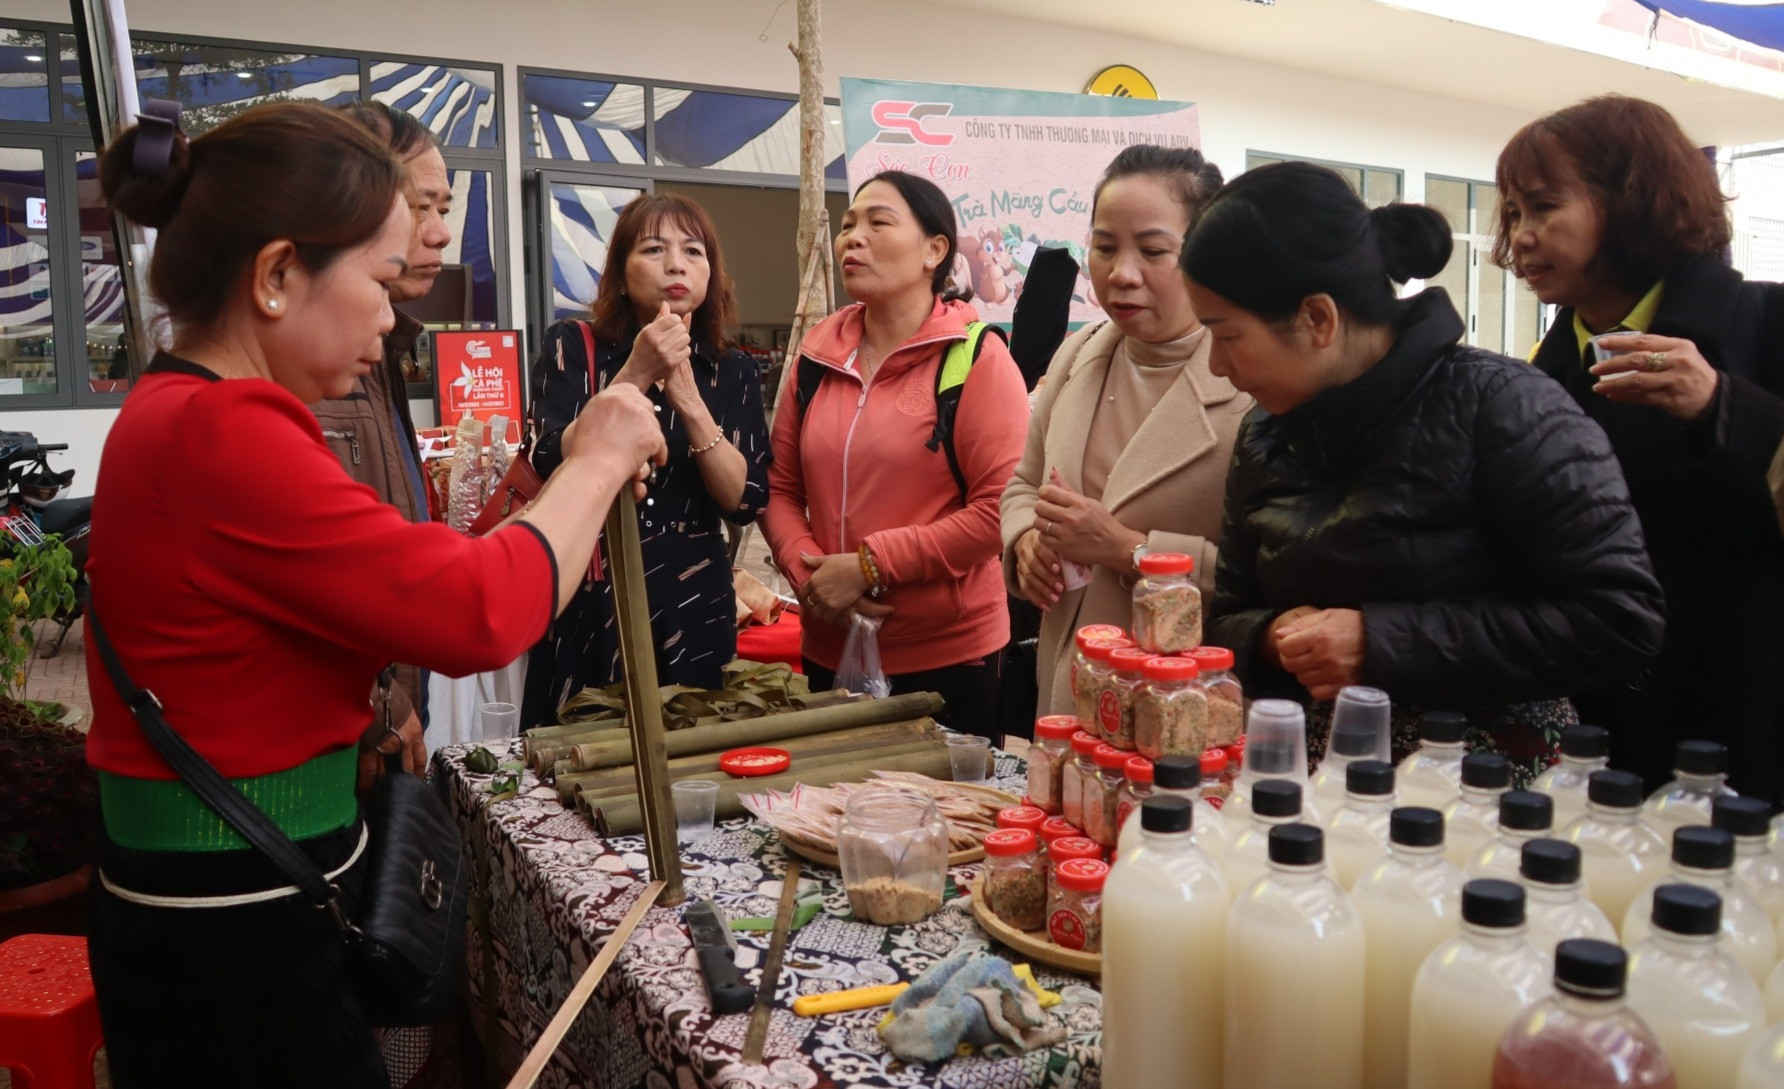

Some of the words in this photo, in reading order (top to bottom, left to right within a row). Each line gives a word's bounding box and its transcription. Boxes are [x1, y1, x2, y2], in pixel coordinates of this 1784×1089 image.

[965, 118, 996, 139] CÔNG
[998, 123, 1012, 139] TY
[1014, 124, 1044, 141] TNHH
[1046, 125, 1089, 143] THƯƠNG
[1112, 128, 1127, 146] VÀ
[920, 152, 971, 179] Con
[951, 193, 987, 228] Trà
[991, 189, 1044, 218] Mãng
[1048, 188, 1089, 214] Cầu
[472, 377, 485, 388] CÀ
[486, 377, 503, 388] PHÊ
[485, 366, 503, 379] HỘI
